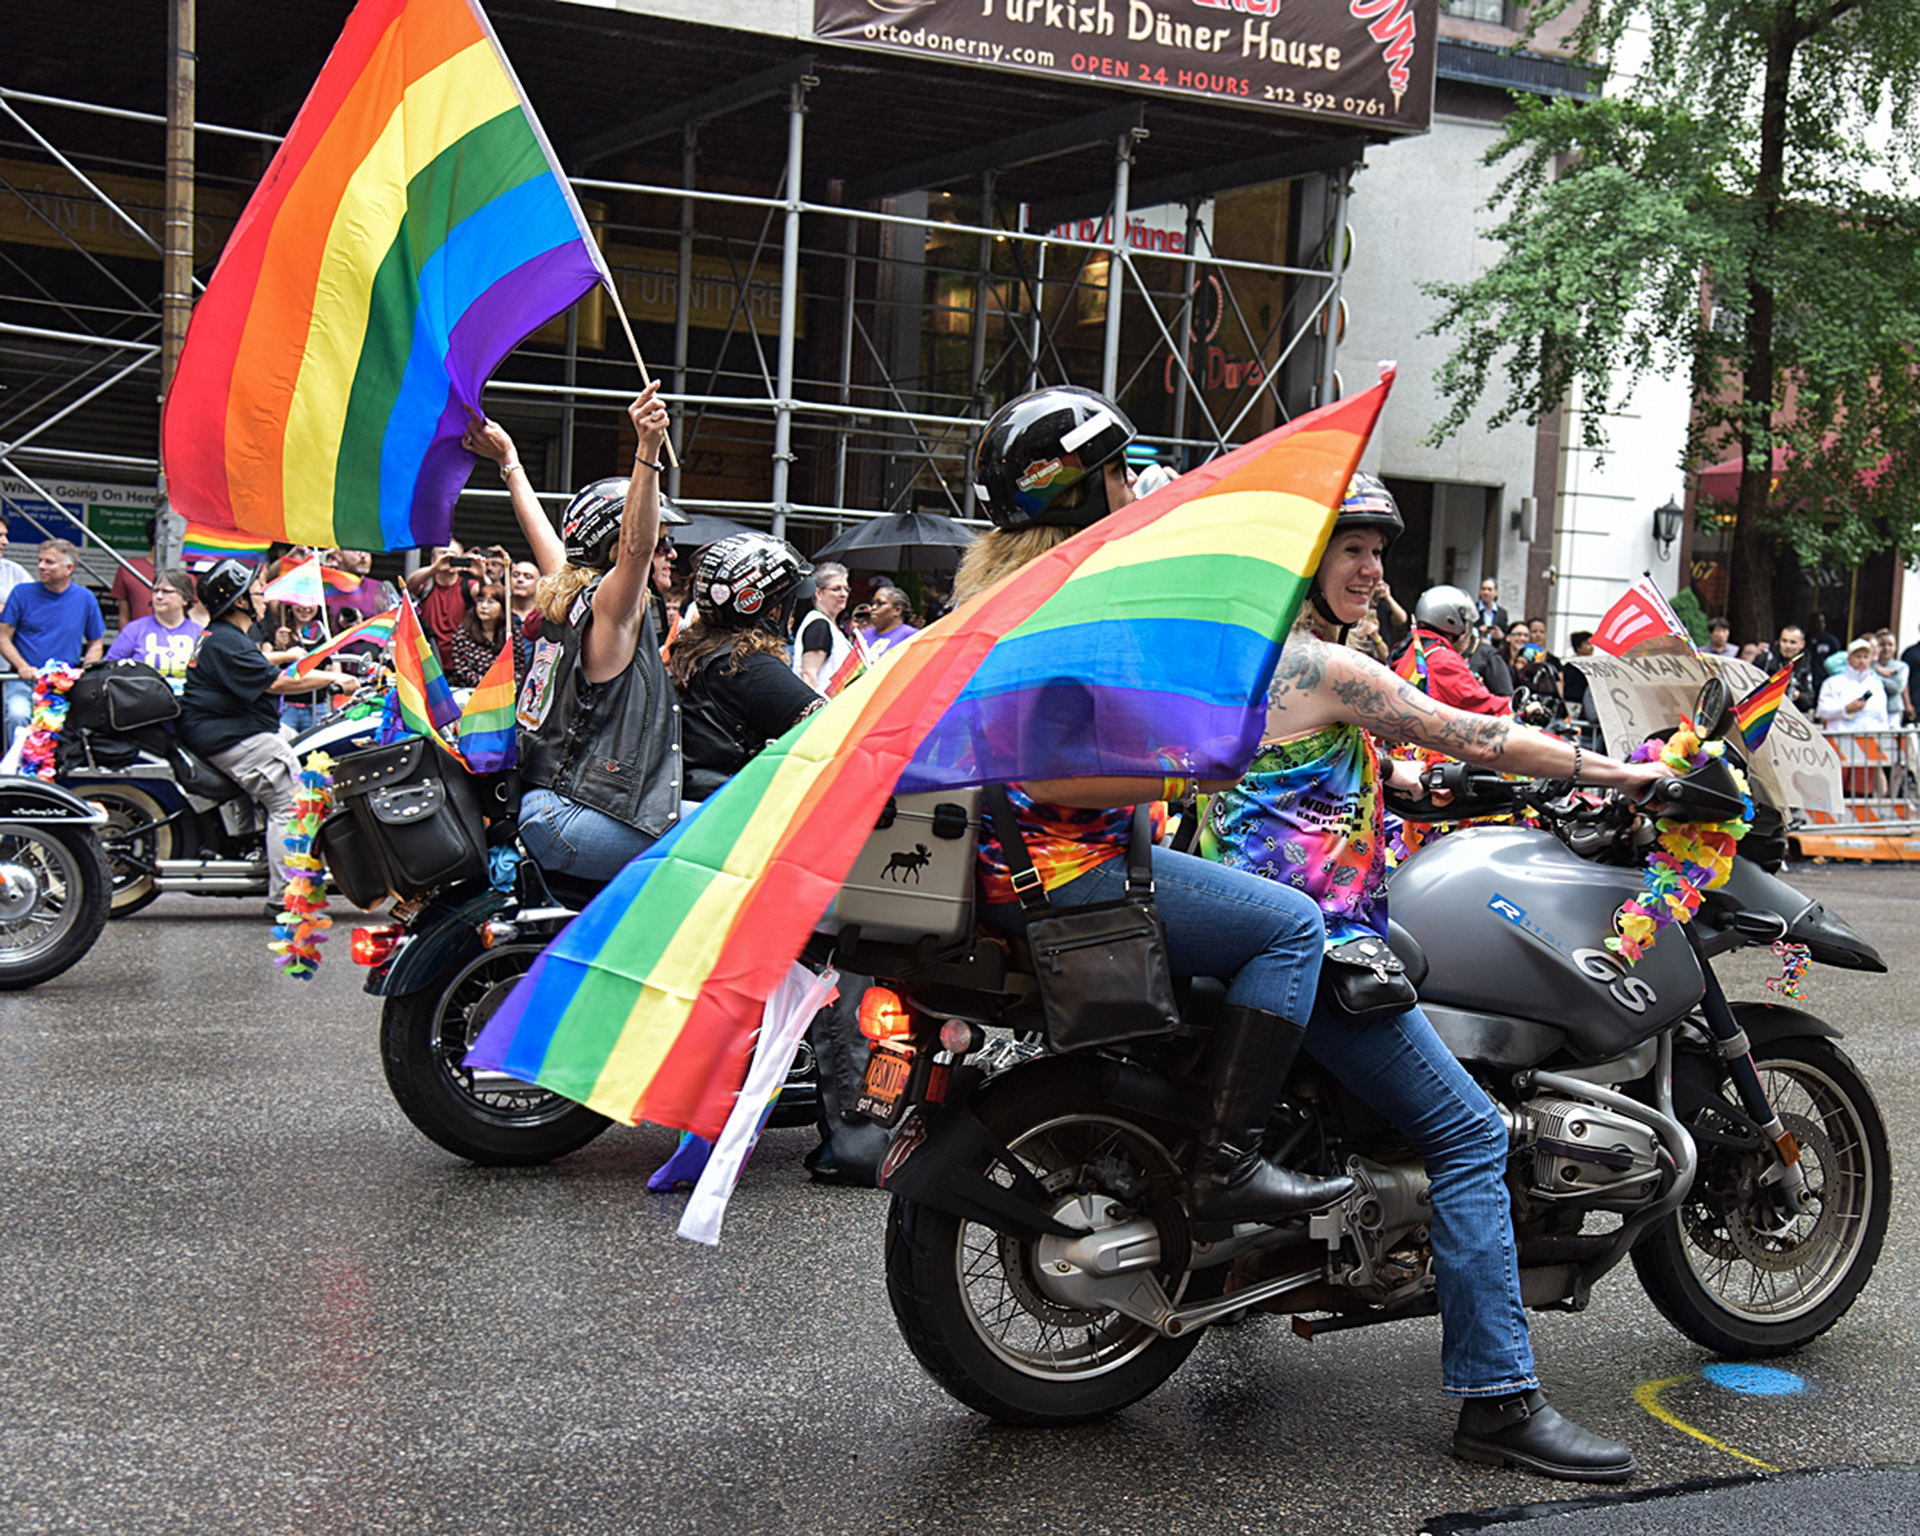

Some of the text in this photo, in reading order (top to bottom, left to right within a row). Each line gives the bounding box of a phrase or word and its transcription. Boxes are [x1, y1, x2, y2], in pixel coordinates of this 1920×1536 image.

[864, 23, 1055, 67] ottodonerny.com
[1071, 53, 1250, 96] OPEN 24 HOURS
[1263, 85, 1385, 116] 212 592 0761
[24, 182, 215, 248] ANTIQUS
[55, 484, 99, 503] Going
[102, 488, 123, 501] On
[1690, 560, 1719, 581] 67
[1490, 899, 1522, 921] R
[1571, 947, 1658, 1014] GS
